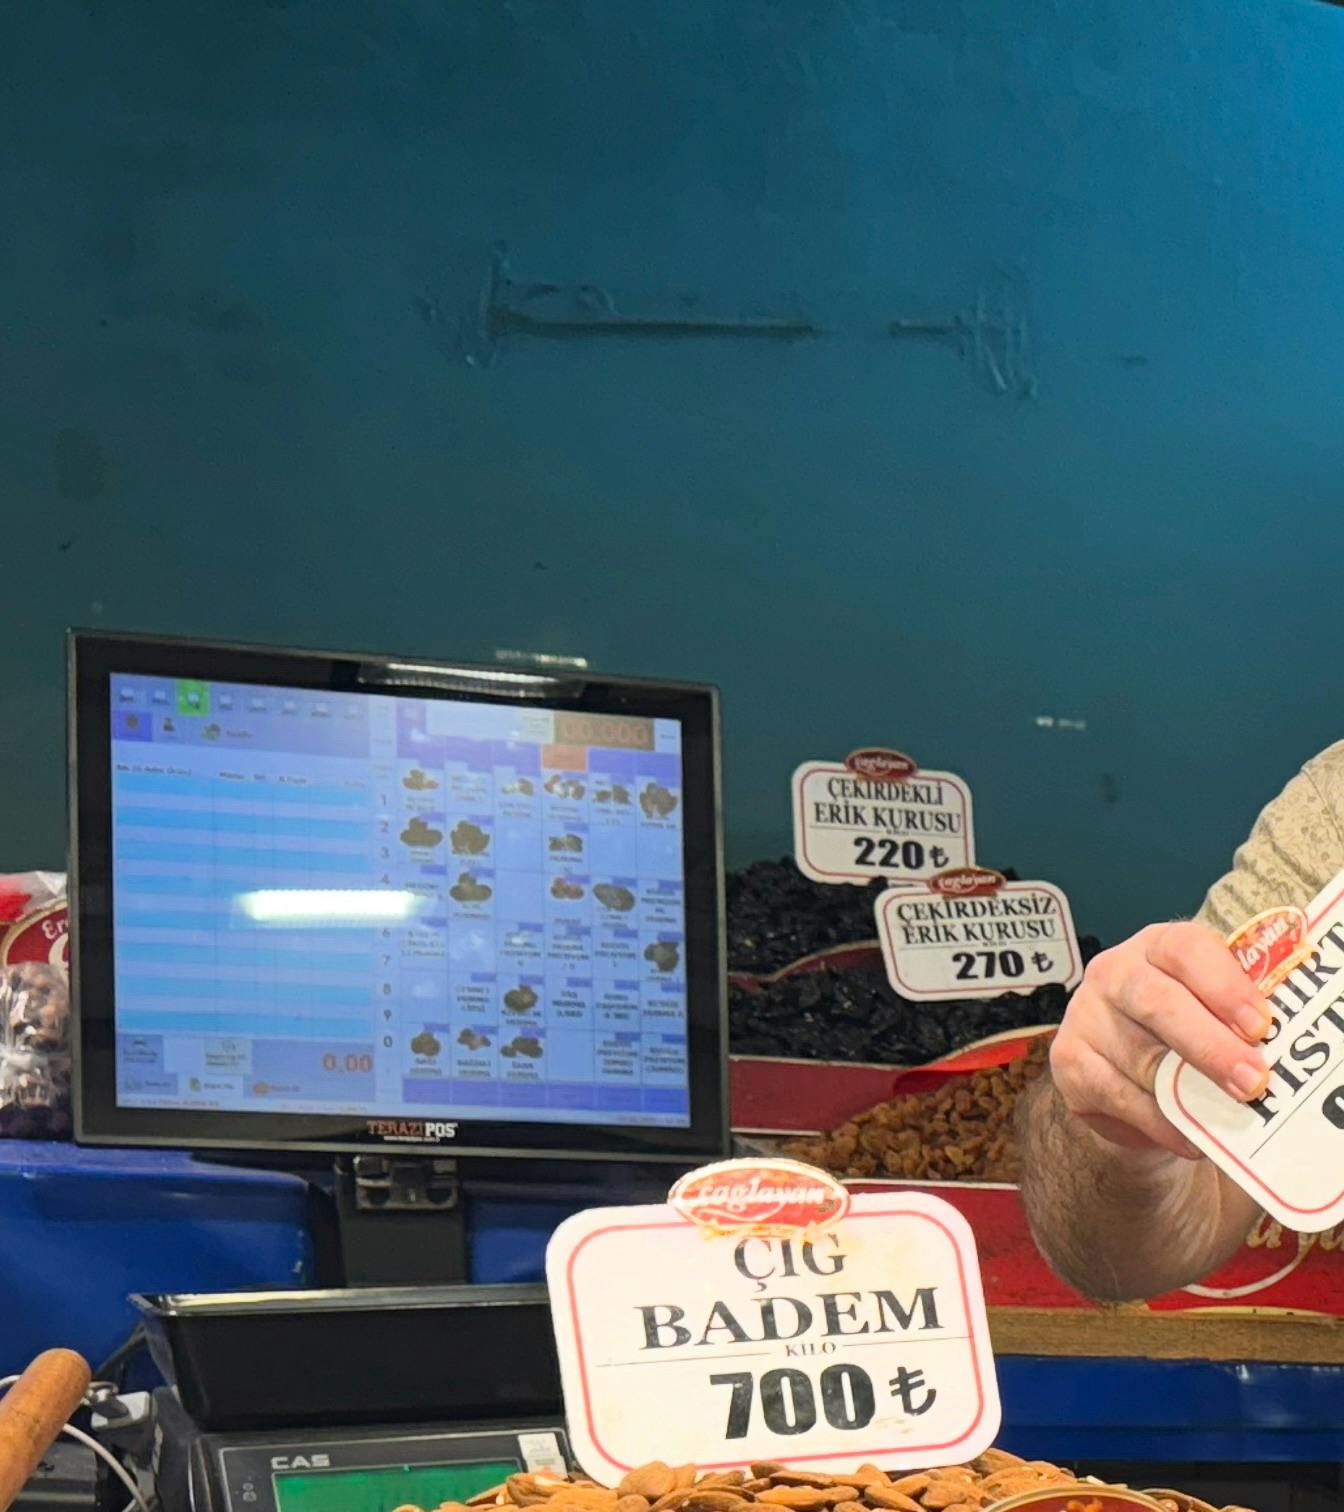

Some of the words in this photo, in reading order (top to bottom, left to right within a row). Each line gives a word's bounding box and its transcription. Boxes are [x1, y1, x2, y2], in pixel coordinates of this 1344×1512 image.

[814, 803, 867, 826] ERİK
[873, 808, 961, 834] KURUSU
[965, 919, 1056, 943] KURUSU
[1237, 916, 1289, 971] layan
[634, 1287, 945, 1350] BADEM
[271, 1454, 331, 1470] CAS
